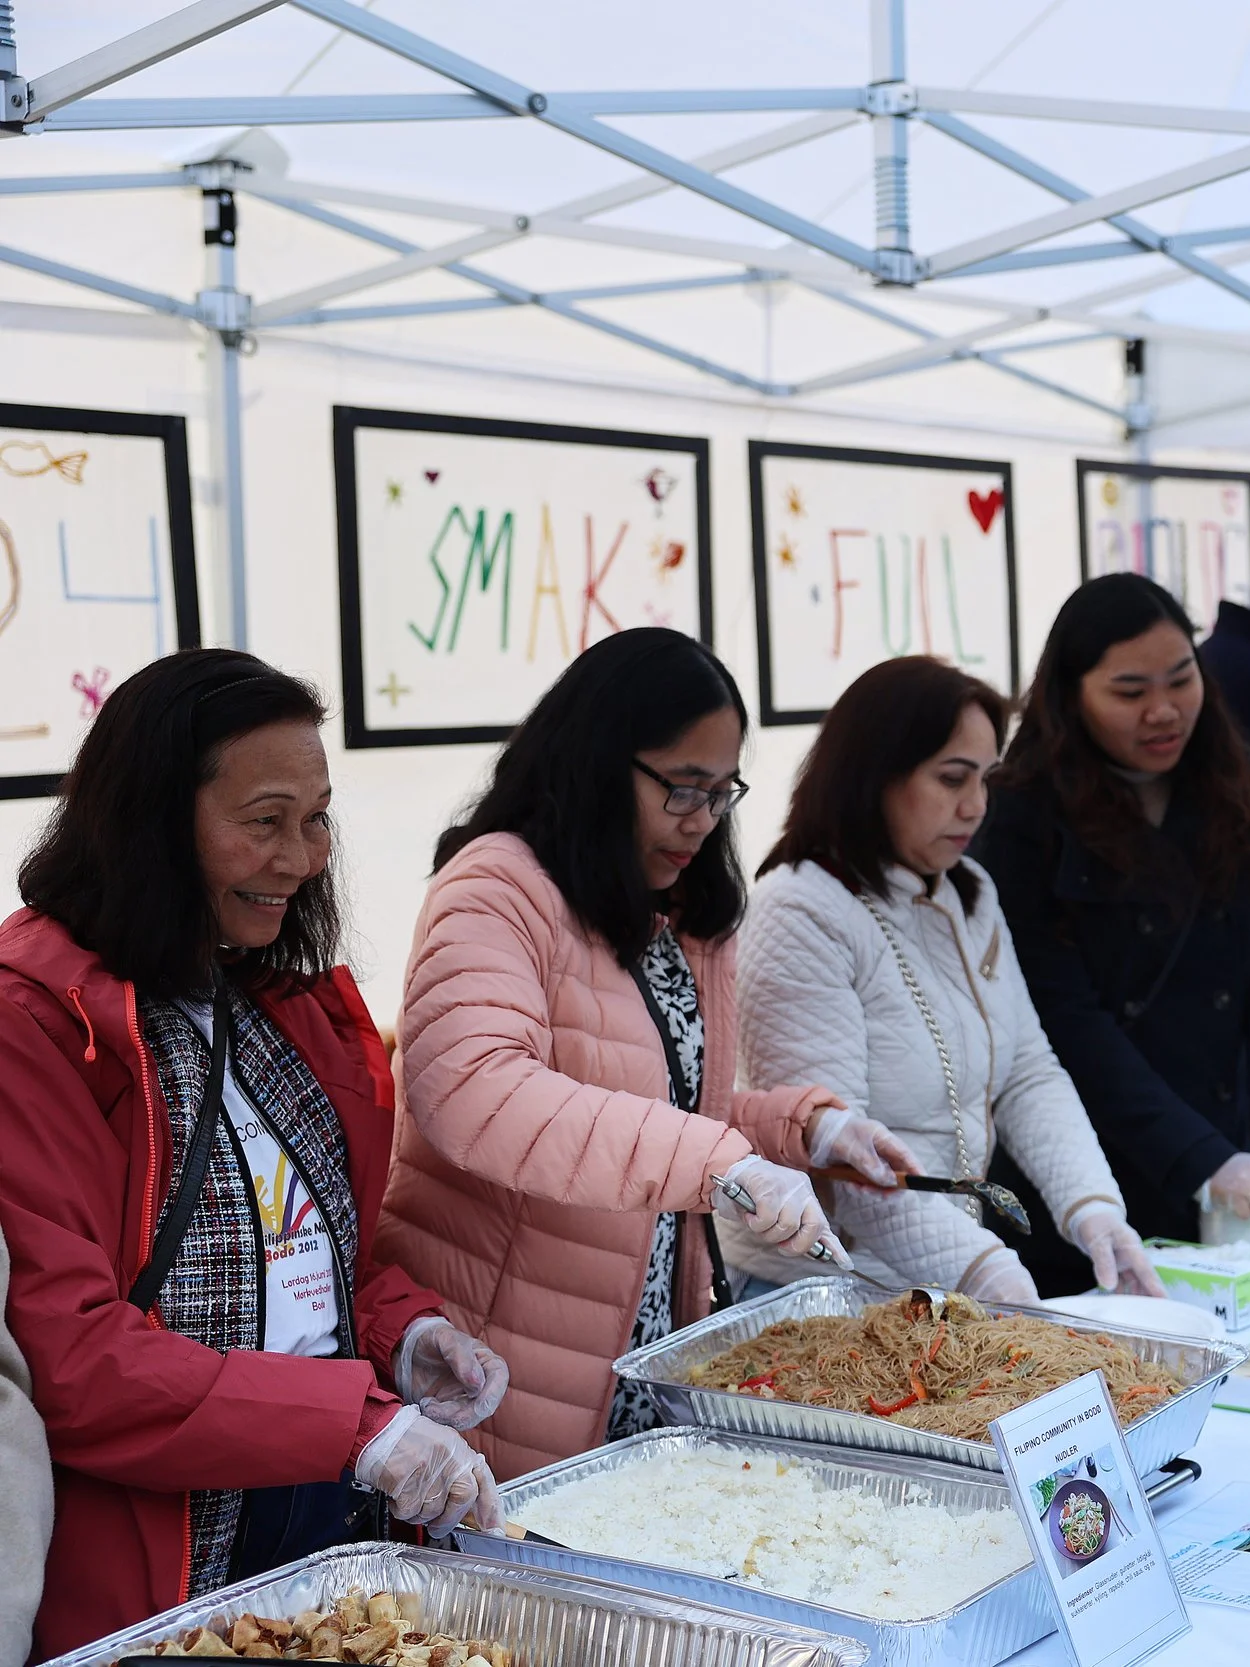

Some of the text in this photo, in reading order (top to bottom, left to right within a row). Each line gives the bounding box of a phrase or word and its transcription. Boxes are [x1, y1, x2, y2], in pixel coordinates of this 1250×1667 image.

[407, 503, 630, 662] SMAK
[829, 528, 985, 663] FULL
[264, 1225, 313, 1247] ilippinske
[298, 1240, 319, 1255] 2012
[1215, 1305, 1227, 1320] M
[1013, 1404, 1102, 1457] FILIPINO COMMUNITY IN BODØ
[1054, 1444, 1079, 1463] NUDLER
